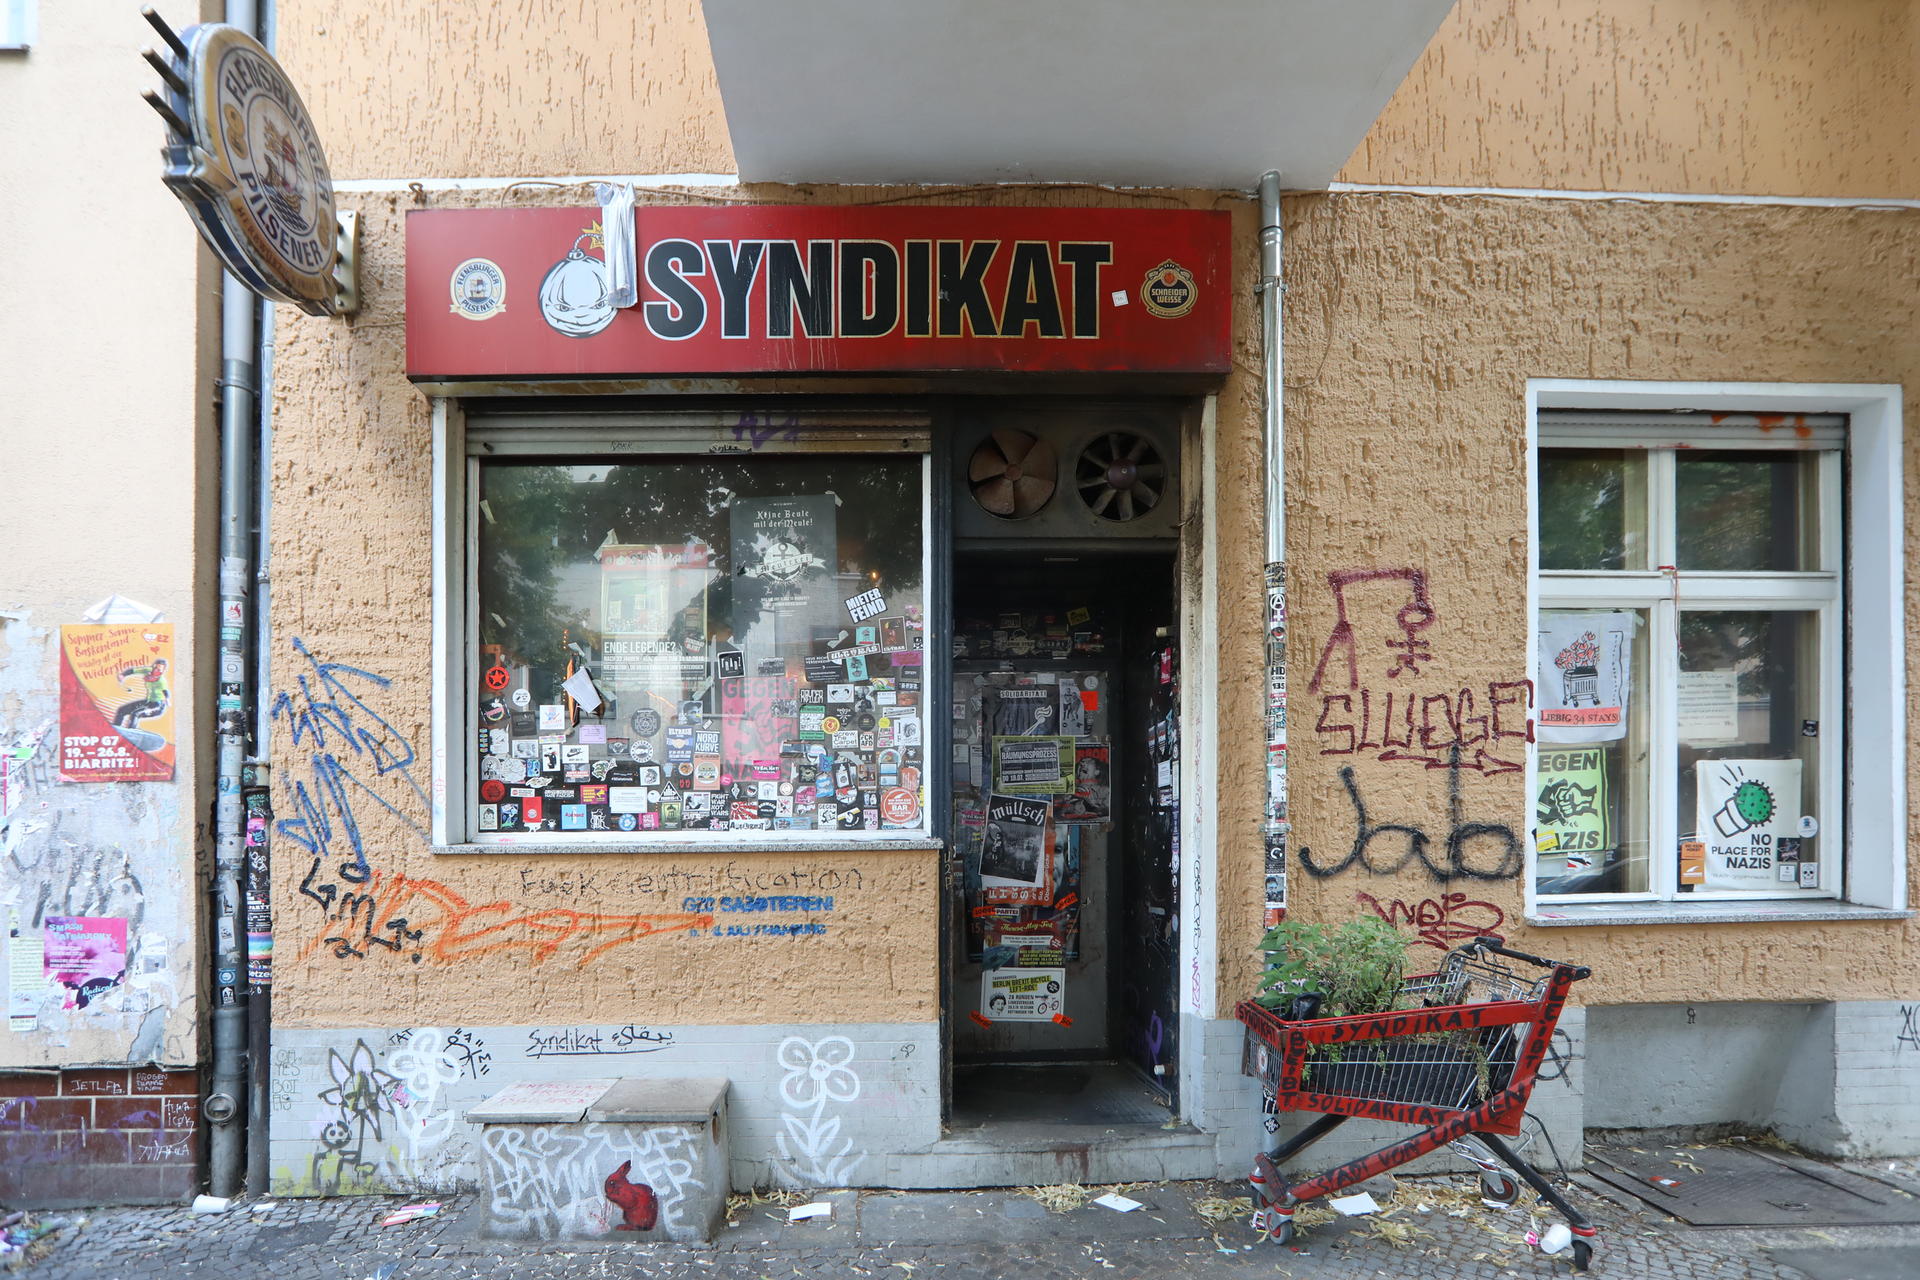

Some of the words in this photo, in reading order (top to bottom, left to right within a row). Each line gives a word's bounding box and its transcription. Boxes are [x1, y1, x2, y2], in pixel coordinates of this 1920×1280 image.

[225, 55, 330, 205] FLENSBURGER
[239, 172, 323, 272] PILSENER
[457, 264, 499, 285] FLENSBURGER
[642, 237, 1114, 341] SYNDIKAT
[1151, 288, 1188, 296] SCHNEIDER
[461, 299, 495, 312] PILSENER
[845, 588, 882, 610] MIETER
[849, 598, 887, 624] FEIND
[604, 642, 630, 653] ENDE
[631, 641, 676, 653] LEGENDE?
[1588, 712, 1618, 721] STAYS
[64, 737, 99, 746] STOP
[102, 736, 118, 746] G7
[697, 733, 718, 743] NORD
[65, 748, 84, 757] 19.
[97, 747, 130, 757] 26.8.
[695, 742, 719, 752] KURVE
[1537, 752, 1598, 772] EGEN
[1751, 833, 1771, 845] NO
[1711, 846, 1748, 856] PLACE
[1751, 847, 1771, 856] FOR
[1726, 857, 1771, 869] NAZIS
[525, 1027, 602, 1059] Syndikat
